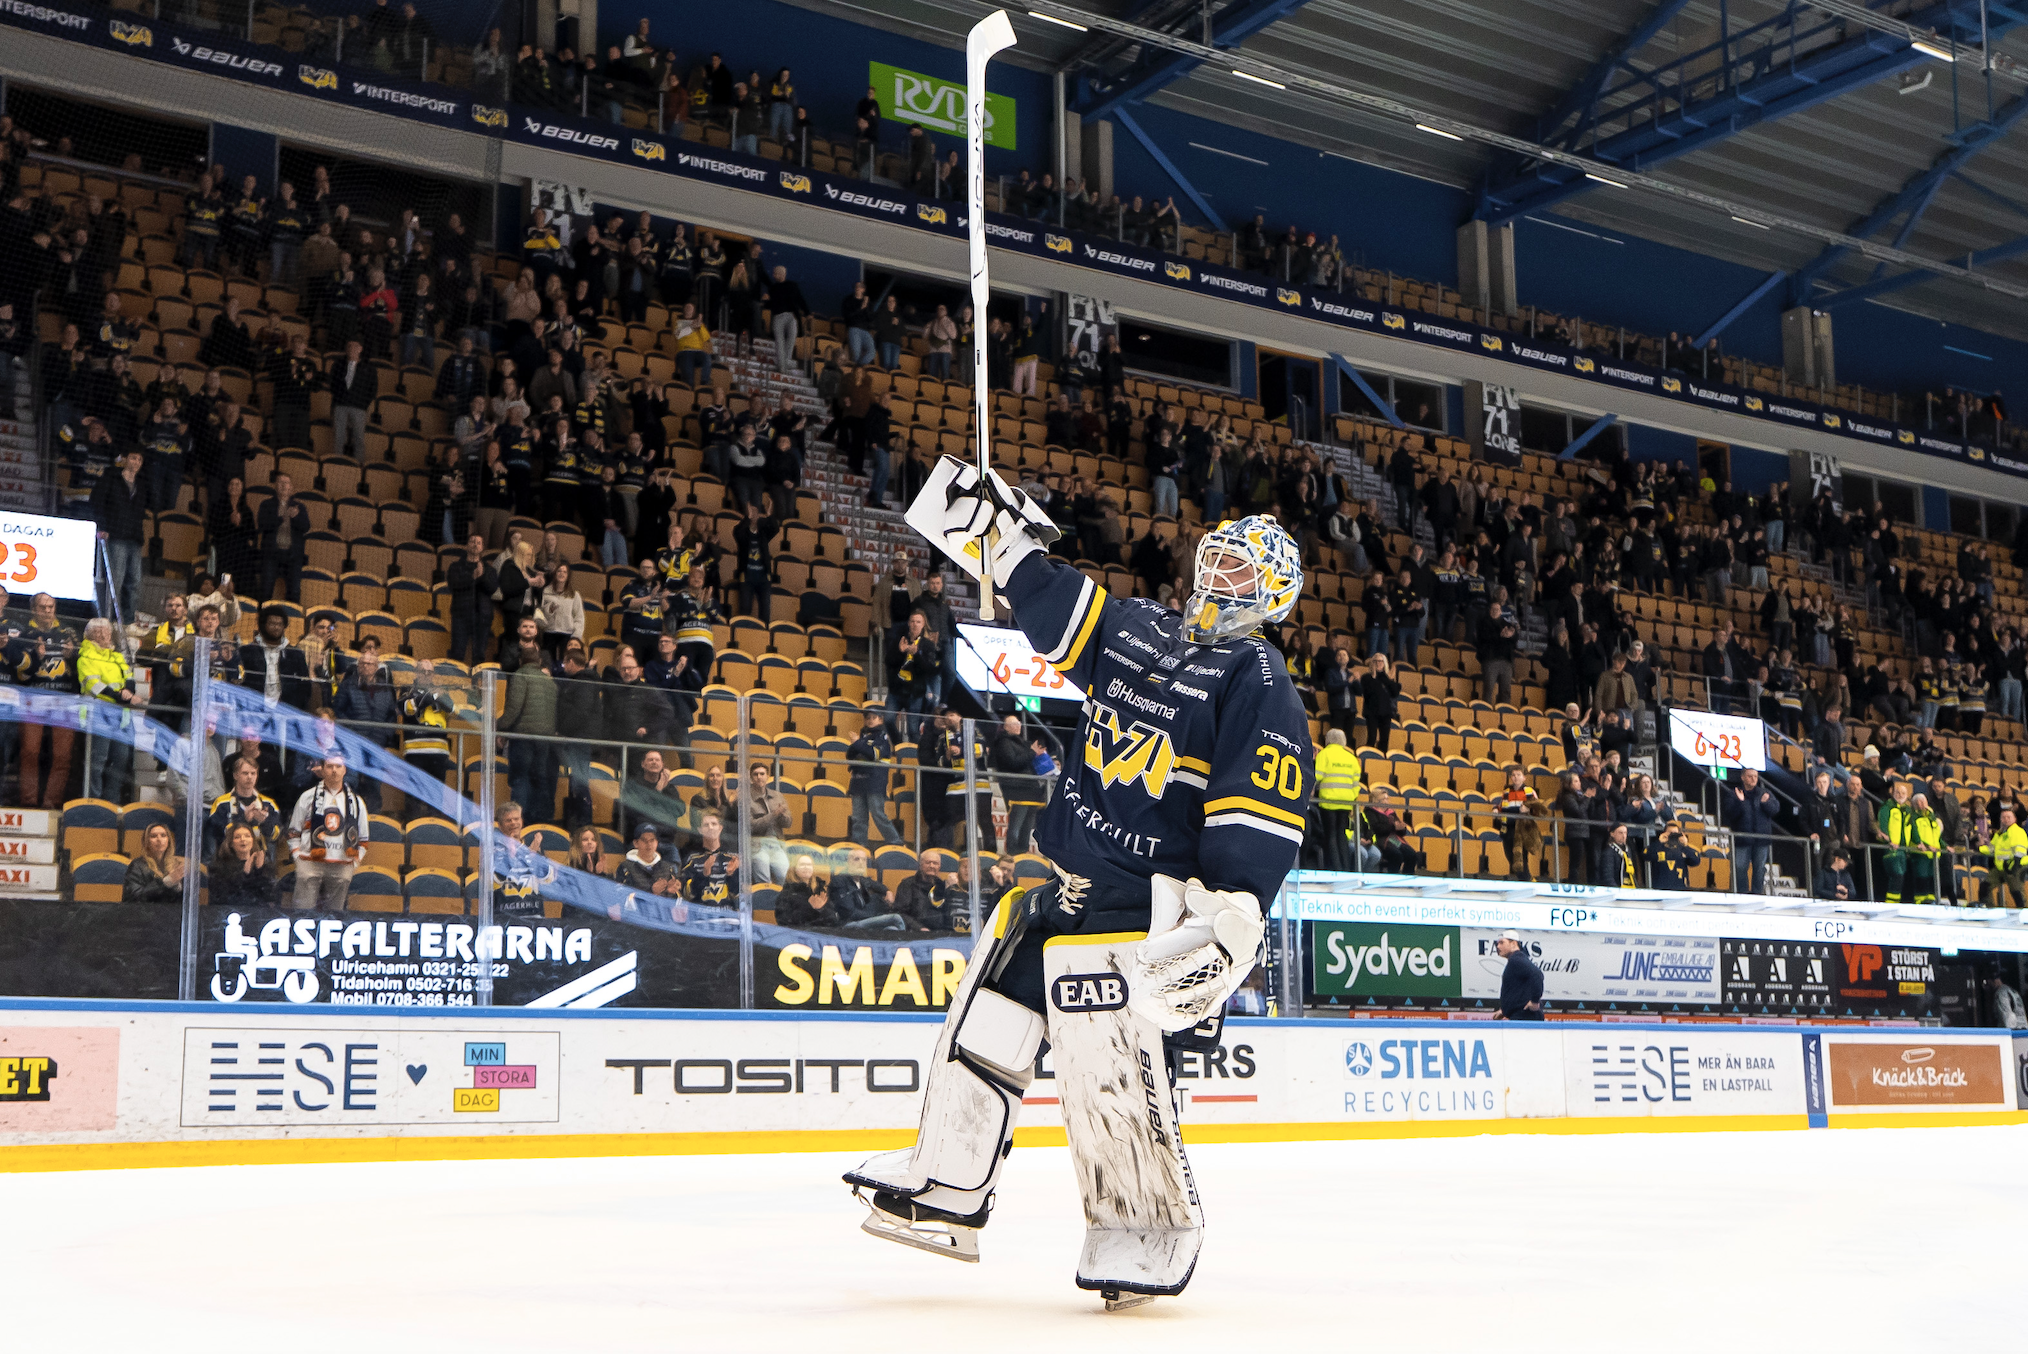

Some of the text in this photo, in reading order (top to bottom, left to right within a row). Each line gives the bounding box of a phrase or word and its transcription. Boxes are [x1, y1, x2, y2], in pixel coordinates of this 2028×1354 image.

[192, 46, 284, 76] BAUER
[366, 85, 459, 115] INTERSPORT
[541, 125, 620, 150] BAUER
[690, 155, 768, 182] INTERSPORT
[839, 191, 907, 215] BAUER
[1098, 251, 1156, 272] BAUER
[1209, 274, 1268, 298] INTERSPORT
[1322, 303, 1375, 323] BAUER
[1421, 323, 1473, 343] INTERSPORT
[1521, 347, 1568, 366] BAUER
[1608, 367, 1656, 386] INTERSPORT
[3, 523, 54, 538] DAGAR
[1108, 651, 1144, 674] INTERSPORT
[1119, 684, 1176, 720] Husqvarna
[1170, 681, 1209, 701] Passera
[1695, 731, 1742, 762] 6-23
[1250, 744, 1302, 801] 30
[1300, 899, 1344, 915] Teknik
[1347, 902, 1372, 916] och
[1375, 904, 1411, 918] event
[1421, 905, 1466, 921] perfekt
[1469, 907, 1521, 923] symbios
[259, 918, 592, 965] ASFALTERARNA
[1326, 930, 1451, 989] Sydved
[1563, 958, 1580, 973] AB
[1603, 950, 1660, 981] JUNE
[1661, 953, 1704, 965] EMBALLAGE
[1891, 948, 1929, 966] STÖRST
[331, 960, 419, 975] Ulricehamn
[422, 962, 485, 977] 0321-25
[1894, 966, 1920, 981] STAN
[1921, 964, 1935, 982] PÅ
[331, 976, 402, 990] Tidaholm
[406, 977, 473, 992] 0502-716
[1058, 979, 1123, 1007] EAB
[331, 991, 473, 1006] Mobil 0708-366 544
[470, 1048, 499, 1061] MIN
[1379, 1039, 1493, 1079] STENA
[1698, 1054, 1775, 1069] MER ÄN BARA
[208, 1042, 379, 1112] HSE
[480, 1071, 530, 1085] STORA
[605, 1058, 920, 1095] TOSITO
[1592, 1045, 1692, 1102] HSE
[1703, 1078, 1773, 1091] EN LASTPALL
[1809, 1051, 1820, 1109] BAUER
[1872, 1066, 1967, 1087] Knäck&Bräck
[460, 1093, 494, 1107] DAG
[1139, 1048, 1167, 1147] BAUER
[1344, 1091, 1494, 1112] RECYCLING
